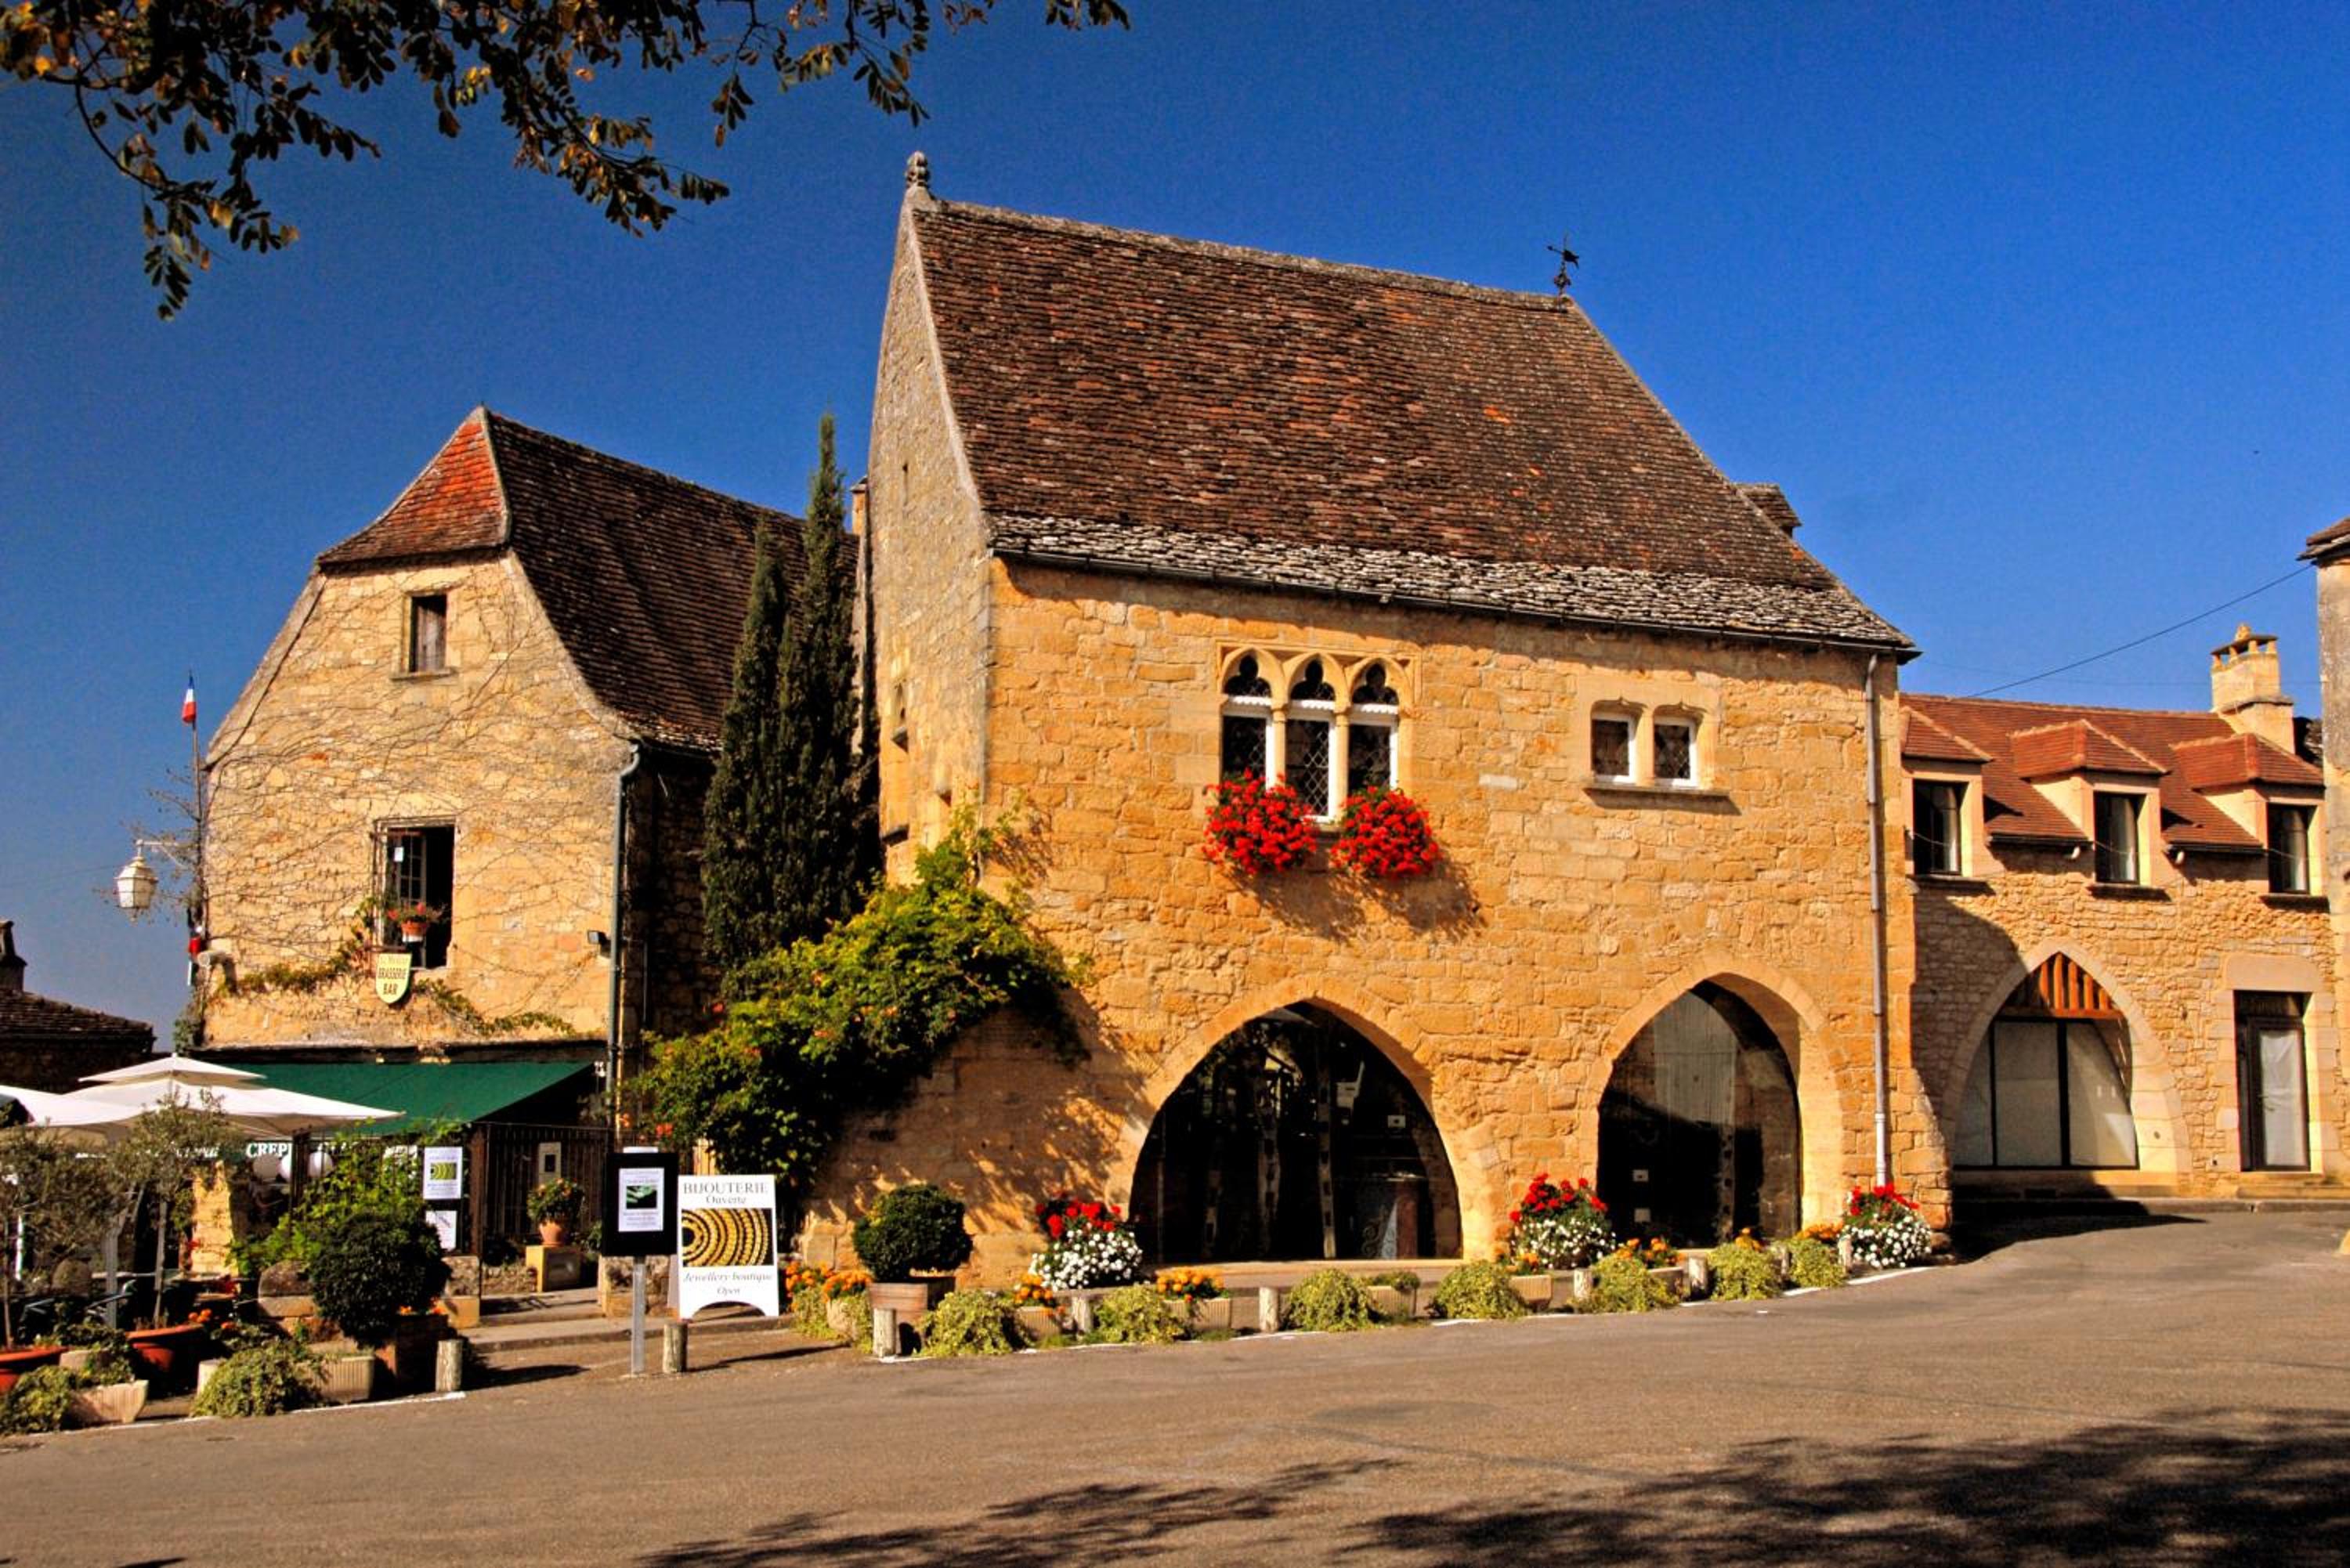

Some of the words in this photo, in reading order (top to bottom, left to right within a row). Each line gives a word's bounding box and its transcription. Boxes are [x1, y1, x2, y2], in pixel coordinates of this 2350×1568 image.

[383, 983, 398, 995] BAR
[684, 1181, 768, 1194] BIJOUTERIE
[706, 1195, 747, 1205] Ouverte
[683, 1272, 728, 1283] Jewellery
[730, 1271, 772, 1282] boutique
[717, 1286, 740, 1295] Open
